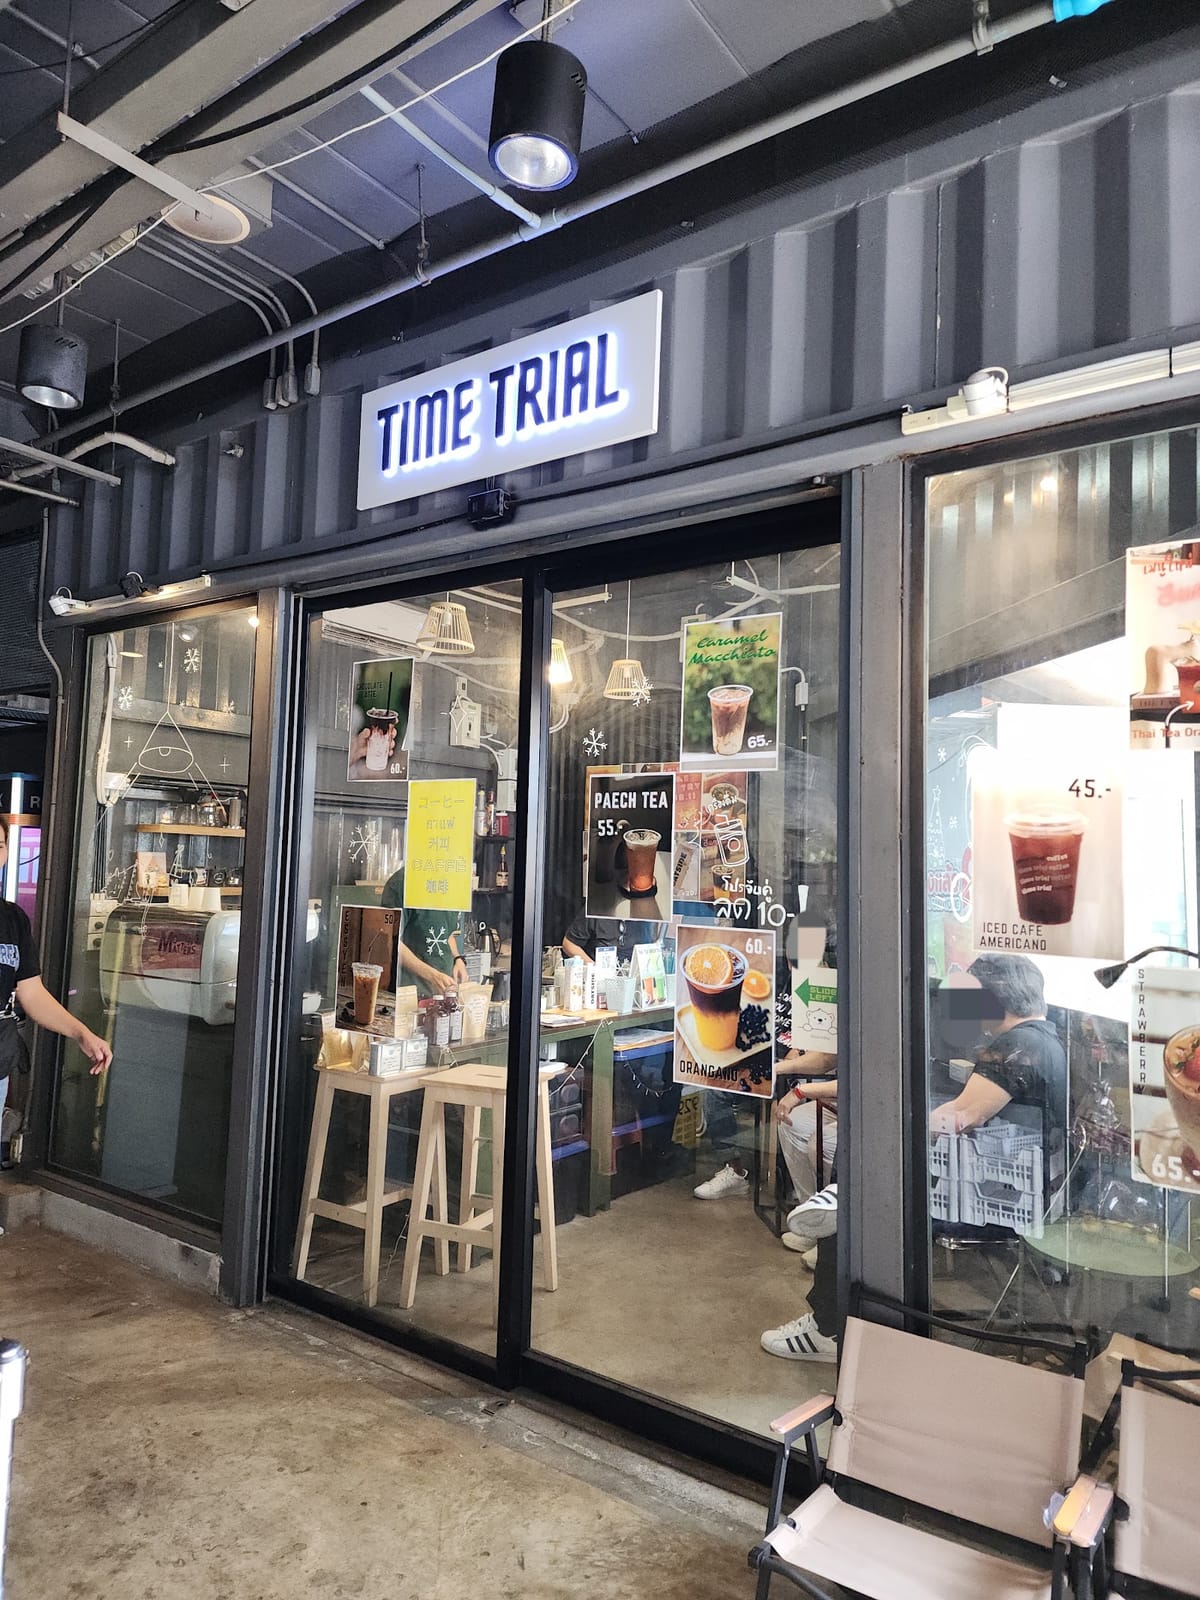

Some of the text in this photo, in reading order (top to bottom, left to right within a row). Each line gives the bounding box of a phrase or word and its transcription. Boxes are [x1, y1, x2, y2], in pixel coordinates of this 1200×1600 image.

[377, 333, 620, 472] TIME TRIAL
[697, 629, 769, 649] Caramel
[688, 646, 776, 665] Macchiato
[747, 734, 773, 749] 65.-
[1132, 729, 1156, 739] Thai
[1161, 727, 1181, 738] Tea
[1068, 778, 1112, 798] 45.-
[417, 796, 465, 809] コーヒー
[594, 791, 668, 809] PAECH TEA
[597, 818, 623, 837] 55.-
[428, 836, 450, 851] 커피
[721, 875, 773, 903] โปรจับคู่
[983, 922, 1043, 937] ICED CAFE
[745, 938, 772, 955] 60.-
[980, 936, 1047, 951] AMERICANO
[809, 985, 837, 996] SLIDE
[809, 993, 834, 1003] LEFT
[1137, 968, 1147, 1095] STRAWBERRY
[679, 1060, 738, 1082] ORANGANO
